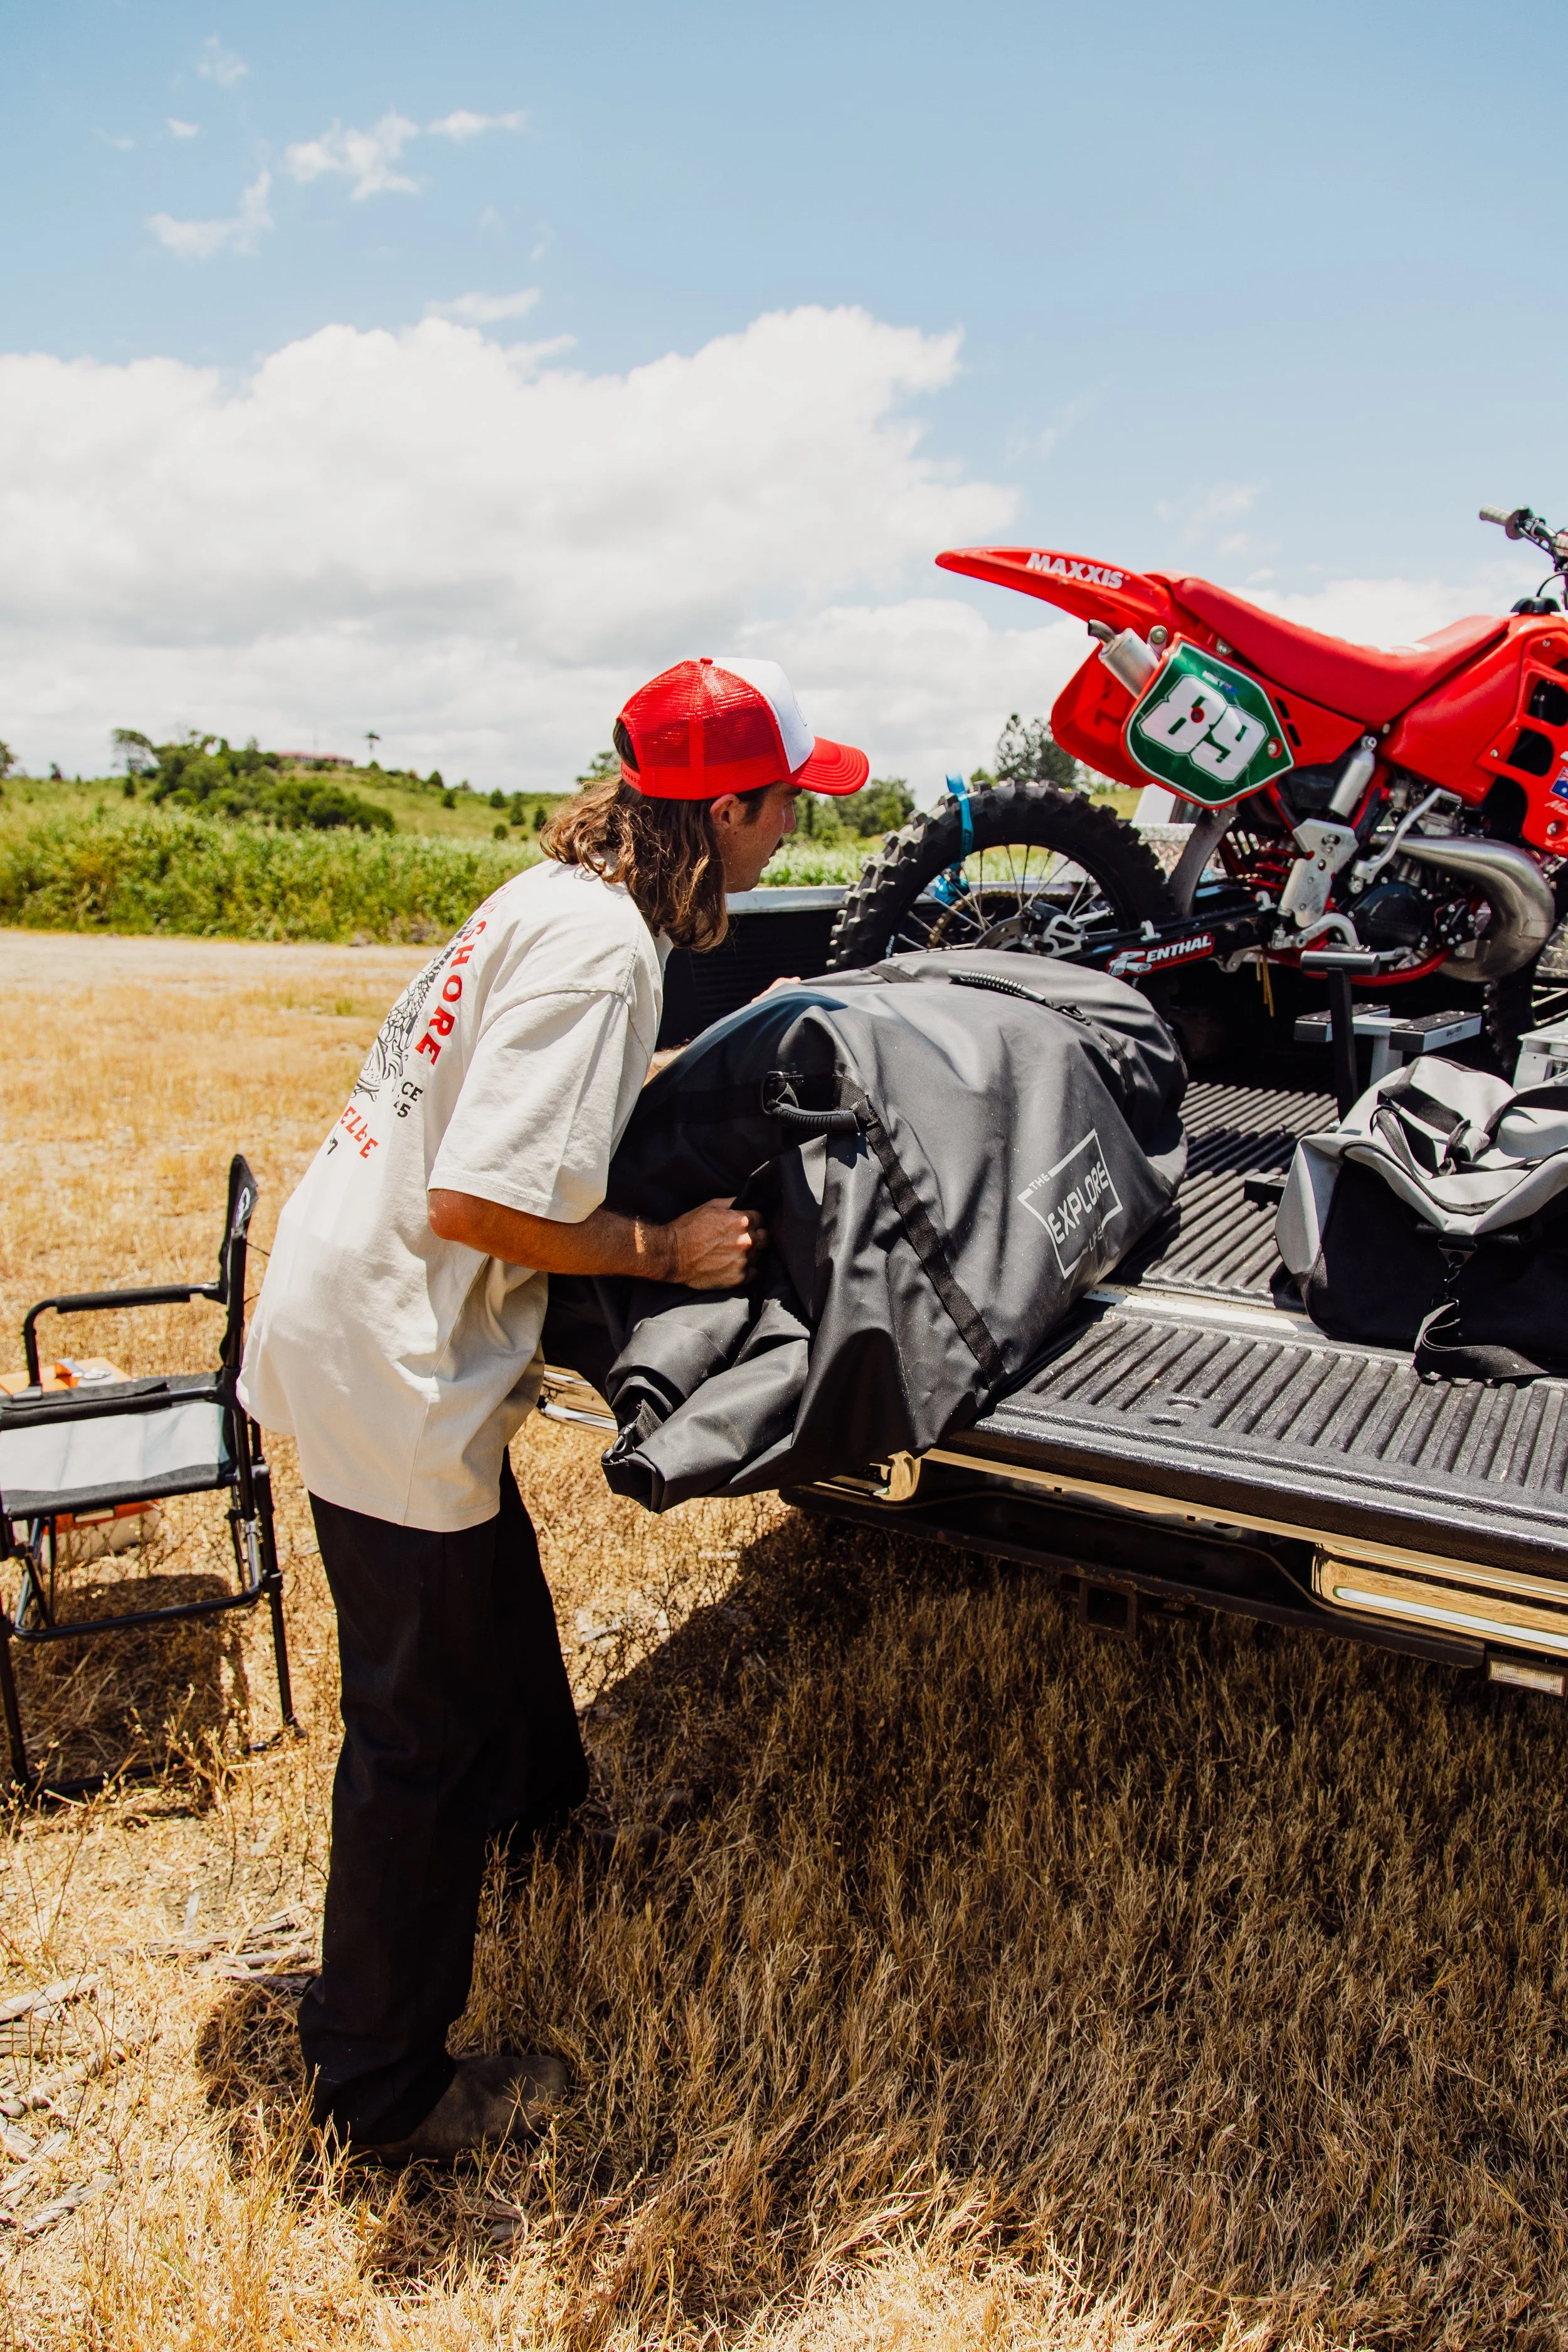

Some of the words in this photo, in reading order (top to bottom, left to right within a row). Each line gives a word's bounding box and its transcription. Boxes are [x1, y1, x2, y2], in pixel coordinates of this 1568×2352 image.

[1025, 552, 1125, 589] MAXXIS
[1138, 675, 1268, 783] 89
[1108, 935, 1212, 977] RENTHAL
[1029, 1173, 1051, 1191] THE
[1047, 1160, 1109, 1244] EXPLORE
